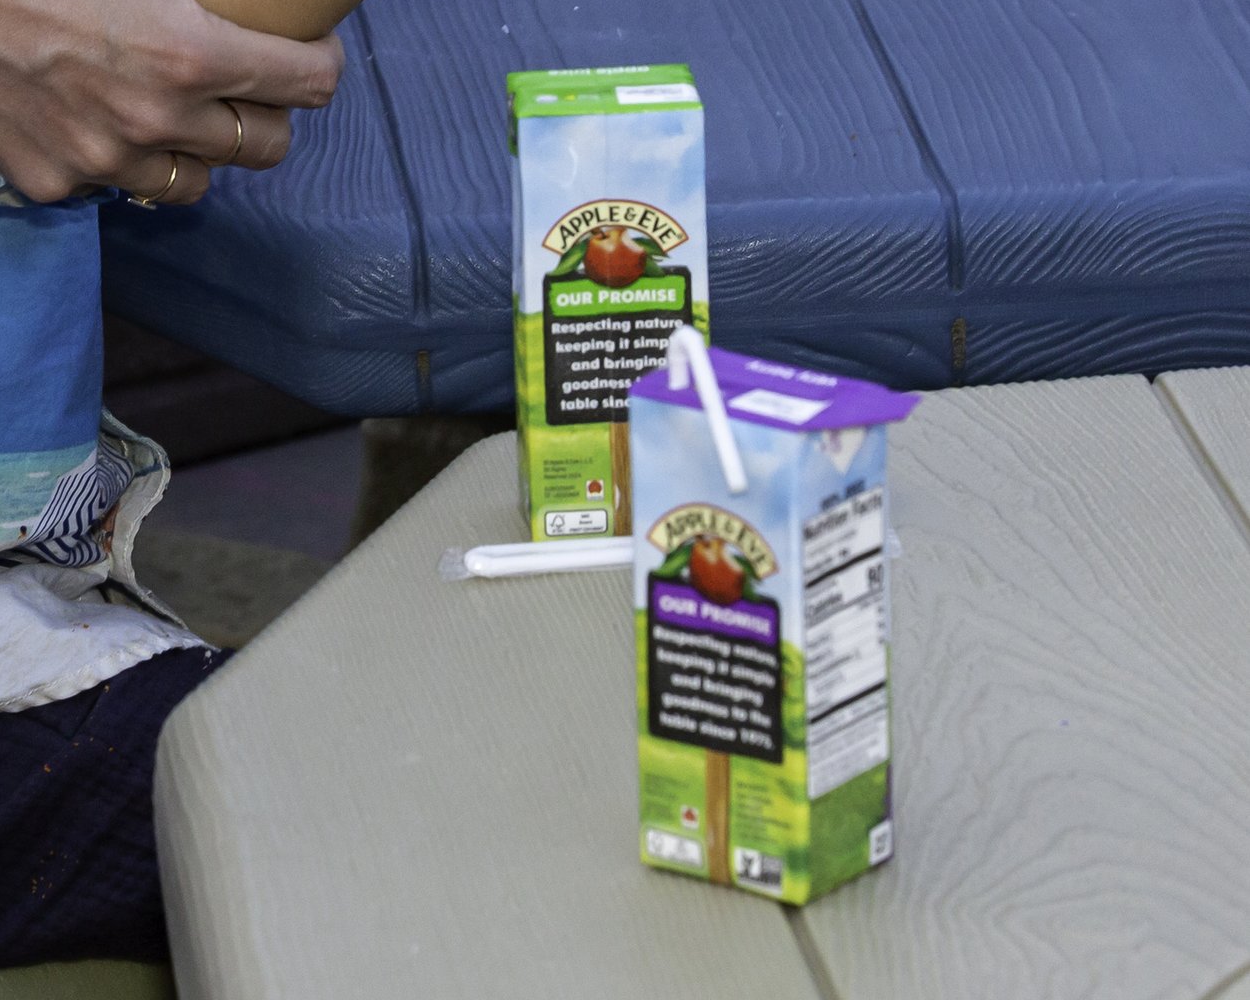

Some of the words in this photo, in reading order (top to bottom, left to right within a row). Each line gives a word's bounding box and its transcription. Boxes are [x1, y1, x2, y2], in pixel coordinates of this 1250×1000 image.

[559, 206, 620, 250] APPLE
[623, 207, 637, 221] &
[638, 208, 677, 244] EVE
[556, 292, 593, 307] OUR
[598, 288, 677, 304] PROMISE
[551, 318, 631, 335] Respecting
[555, 338, 616, 354] keeping
[619, 337, 630, 350] it
[633, 335, 669, 351] simp
[571, 357, 600, 372] and
[562, 377, 632, 395] goodness
[560, 397, 599, 412] table
[658, 595, 699, 618] OUR
[701, 601, 771, 637] PROMISE
